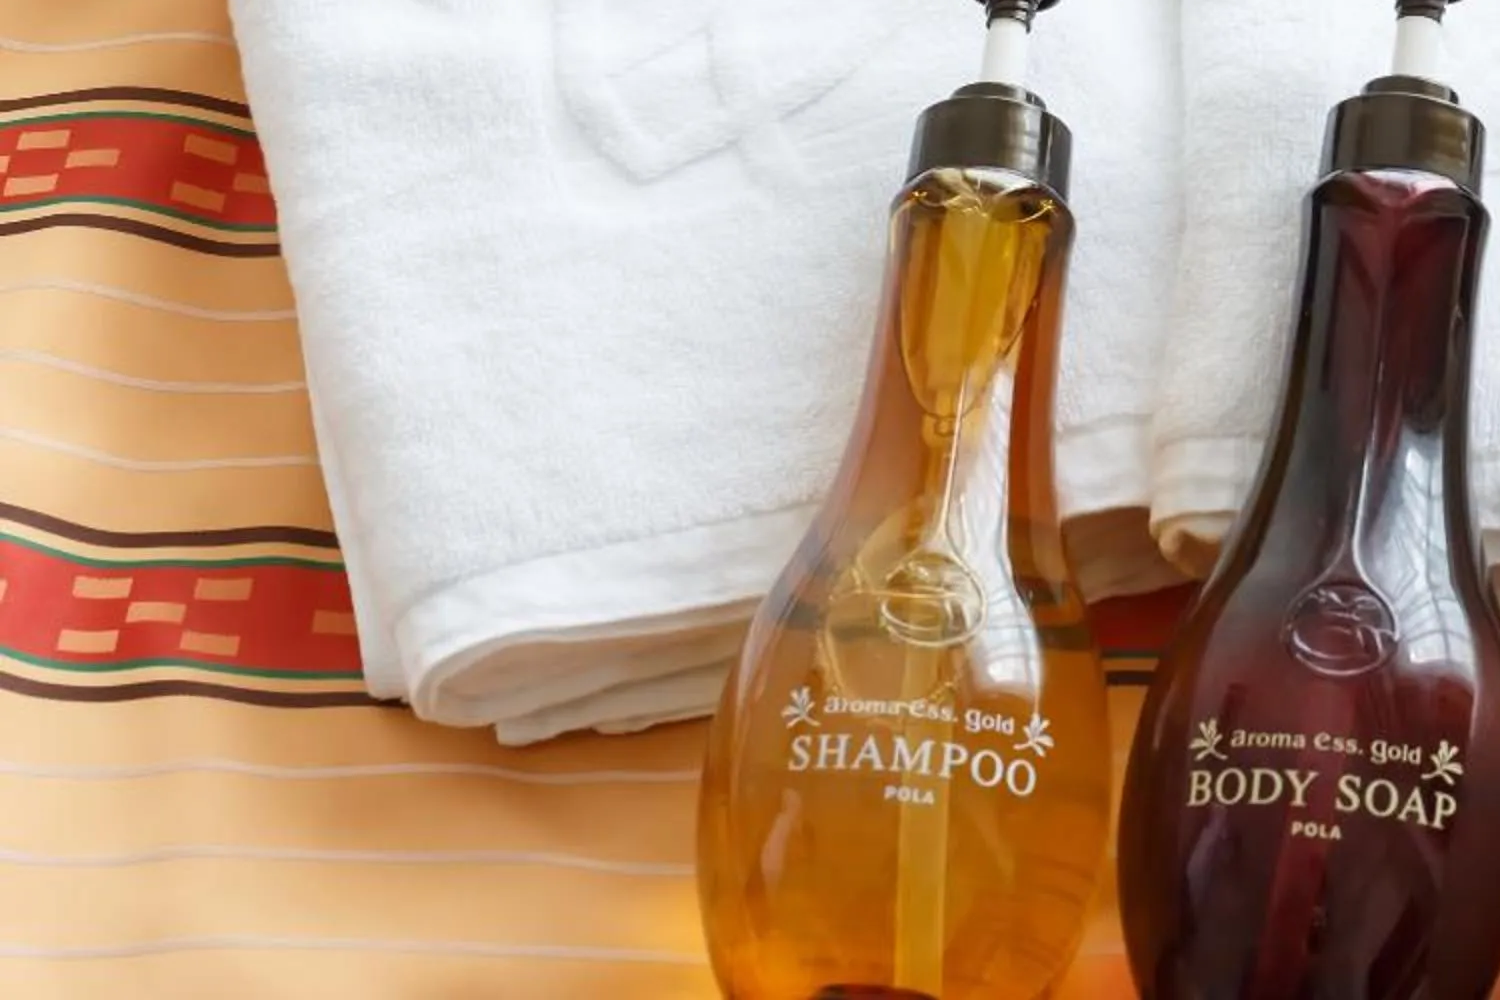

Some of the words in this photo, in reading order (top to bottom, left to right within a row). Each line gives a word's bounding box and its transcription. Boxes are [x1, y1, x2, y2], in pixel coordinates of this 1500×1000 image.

[964, 707, 1015, 735] gold
[1230, 729, 1306, 749] aroma
[1370, 739, 1421, 765] gold
[788, 734, 1037, 797] SHAMPOO
[884, 785, 935, 805] POLA
[1187, 767, 1319, 808] BODY
[1335, 774, 1457, 830] SOAP
[1290, 821, 1342, 840] POLA
